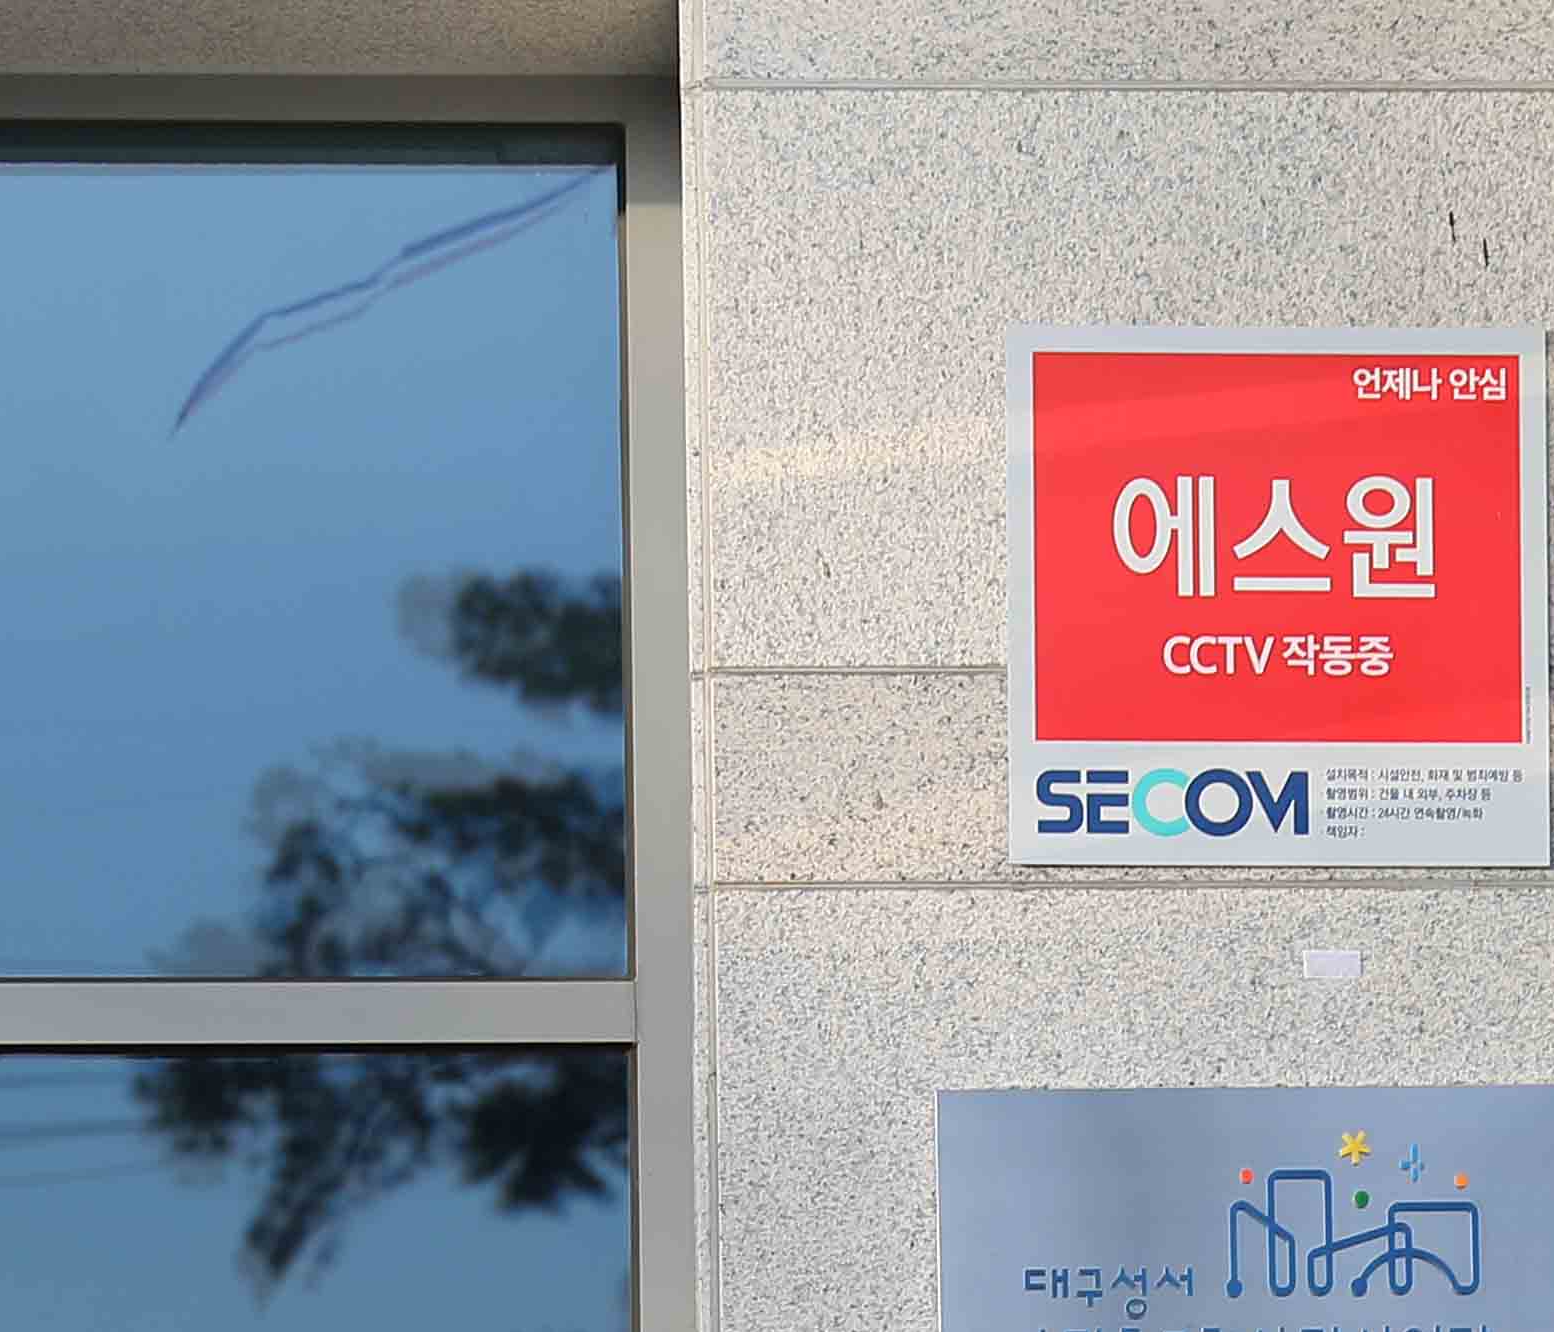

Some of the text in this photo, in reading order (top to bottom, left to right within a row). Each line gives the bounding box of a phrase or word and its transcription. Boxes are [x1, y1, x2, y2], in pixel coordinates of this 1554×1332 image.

[1353, 367, 1507, 401] 언제나 안심
[1113, 475, 1436, 598] 에스원
[1163, 634, 1394, 676] CCTV 작동중
[1036, 768, 1310, 838] SECOM
[1023, 1266, 1196, 1320] 대구성서
